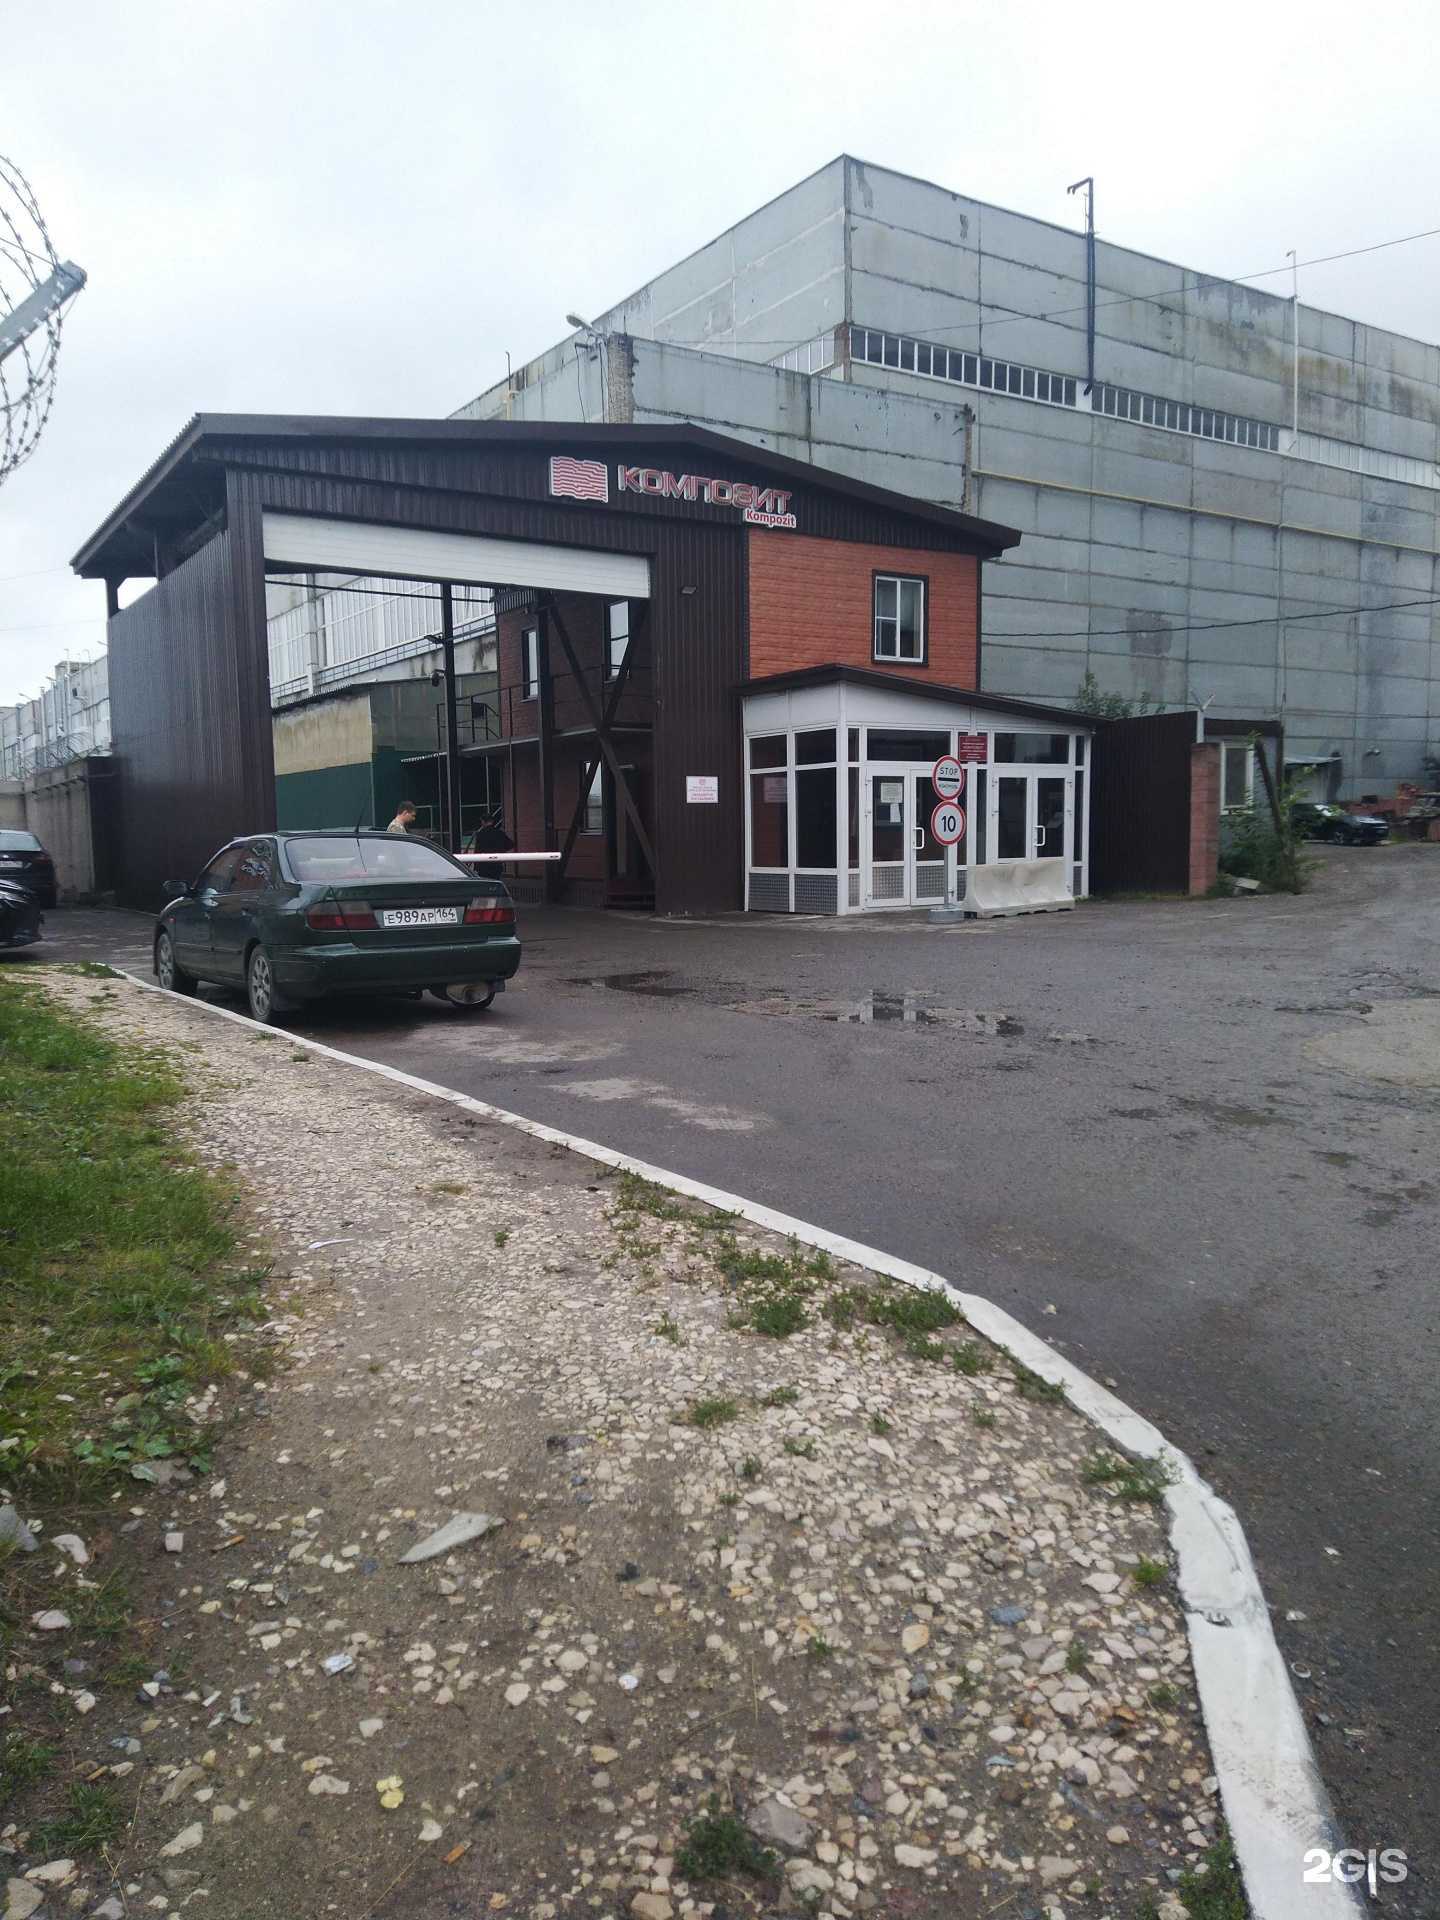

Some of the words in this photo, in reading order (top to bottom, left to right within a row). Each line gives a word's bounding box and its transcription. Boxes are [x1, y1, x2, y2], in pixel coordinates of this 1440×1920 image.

[618, 464, 793, 514] КОМПОЗИТ
[746, 508, 796, 528] Kompozit
[939, 767, 959, 776] STOP
[941, 815, 956, 833] 10
